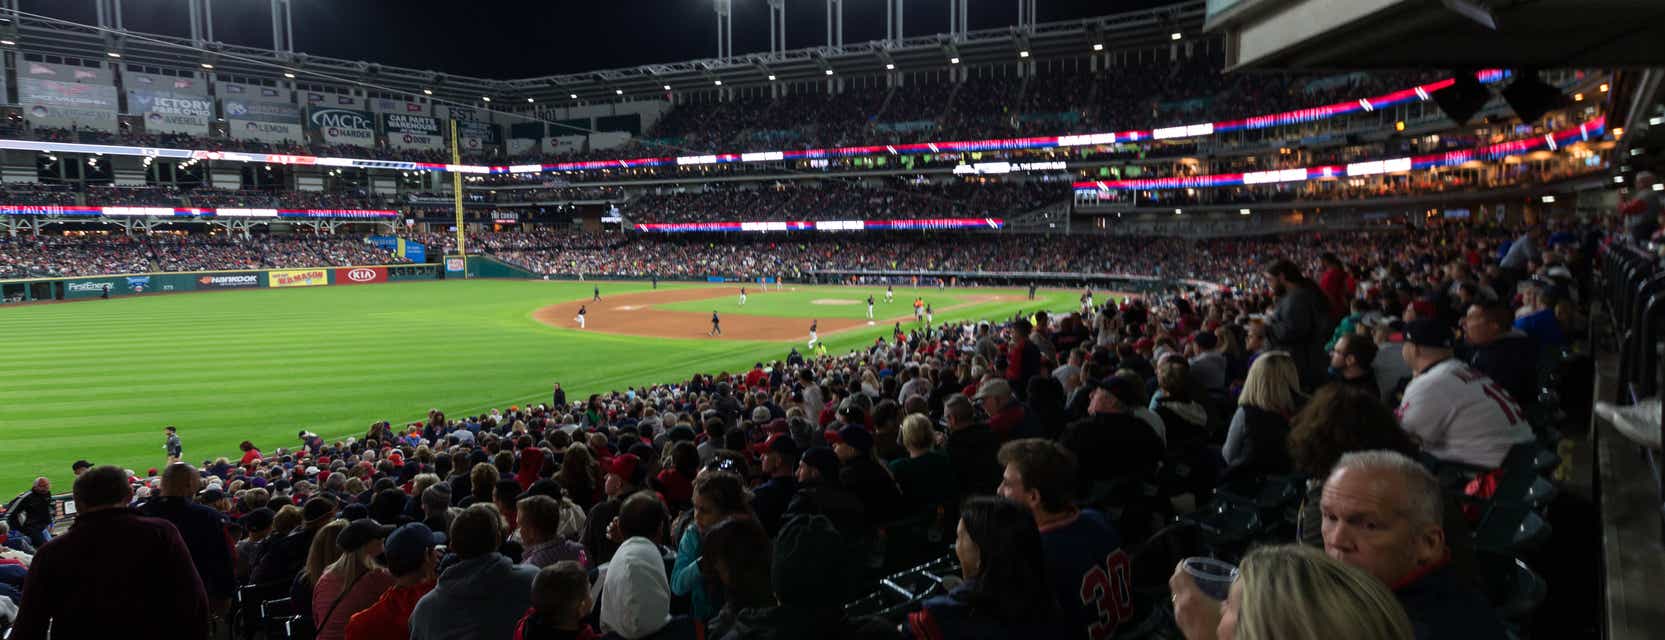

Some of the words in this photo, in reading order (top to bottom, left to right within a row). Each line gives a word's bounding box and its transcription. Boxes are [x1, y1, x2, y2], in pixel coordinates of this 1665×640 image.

[389, 114, 407, 122] CAR
[408, 116, 435, 125] PARTS
[387, 120, 438, 131] WAREHOUSE
[352, 269, 372, 279] KIA
[1080, 548, 1134, 640] 30
